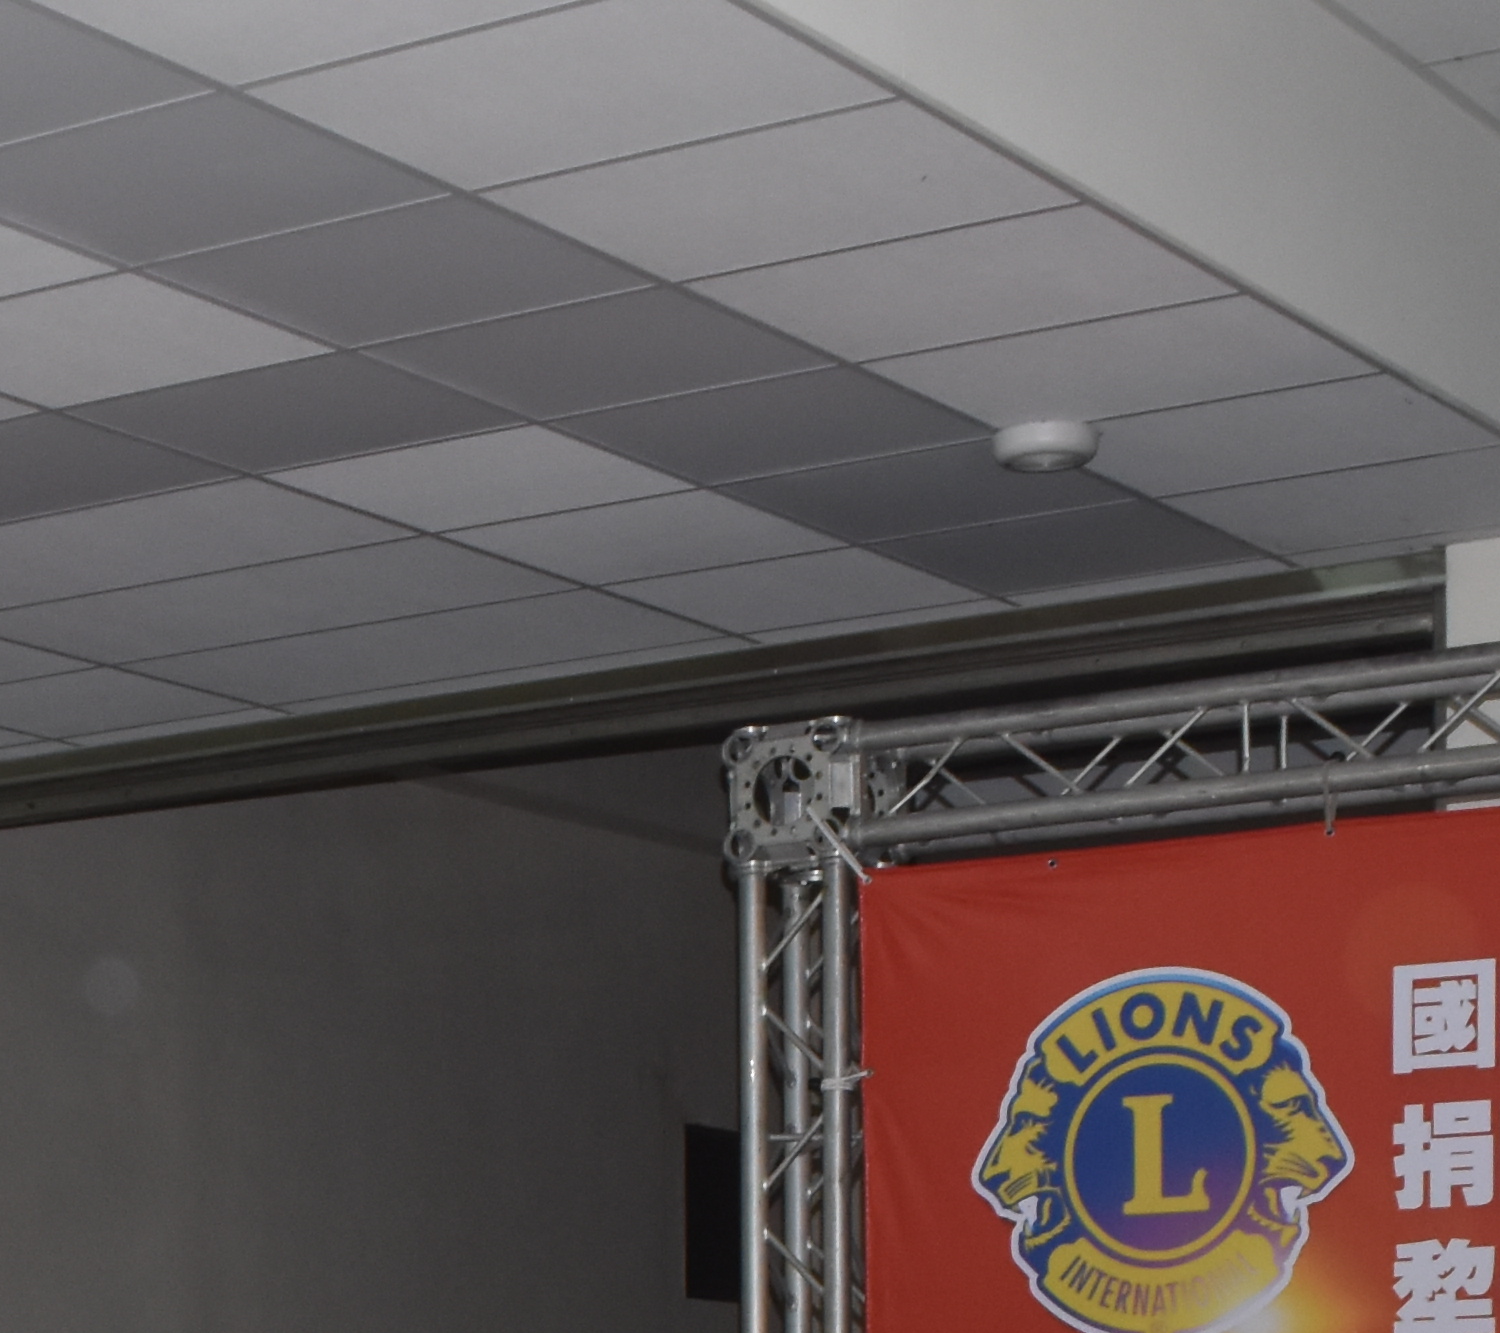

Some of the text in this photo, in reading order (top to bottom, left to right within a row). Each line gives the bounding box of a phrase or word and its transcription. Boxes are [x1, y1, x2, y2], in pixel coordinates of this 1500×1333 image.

[1056, 992, 1263, 1074] LIONS
[1122, 1094, 1210, 1216] L
[1059, 1250, 1262, 1317] INTERNATIONAL
